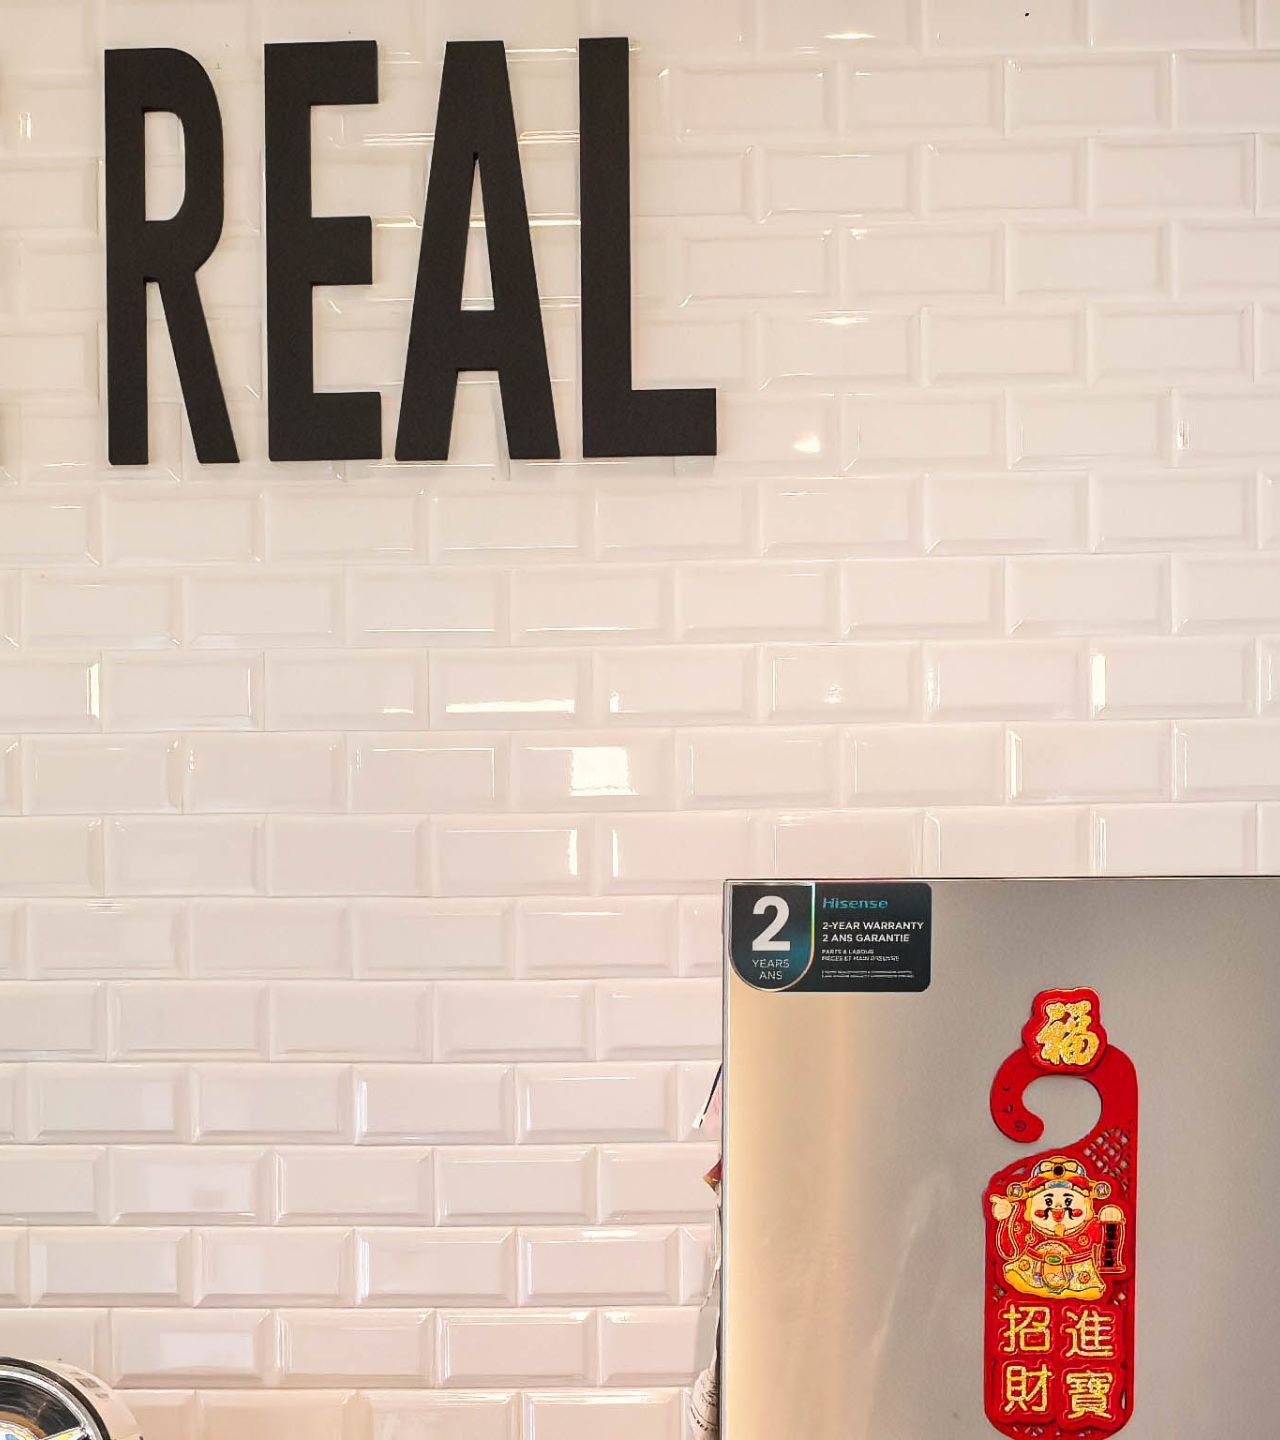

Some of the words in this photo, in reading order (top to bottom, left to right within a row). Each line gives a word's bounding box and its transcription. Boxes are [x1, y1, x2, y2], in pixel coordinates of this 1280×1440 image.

[103, 37, 718, 466] REAL
[822, 897, 889, 909] Hisense
[752, 895, 791, 951] 2
[822, 921, 860, 931] 2-YEAR
[863, 921, 925, 931] WARRANTY
[822, 934, 829, 942] 2
[831, 933, 853, 943] ANS
[855, 933, 911, 943] GARANTIE
[752, 958, 790, 968] YEARS
[759, 971, 783, 980] ANS
[1035, 999, 1101, 1066] 福
